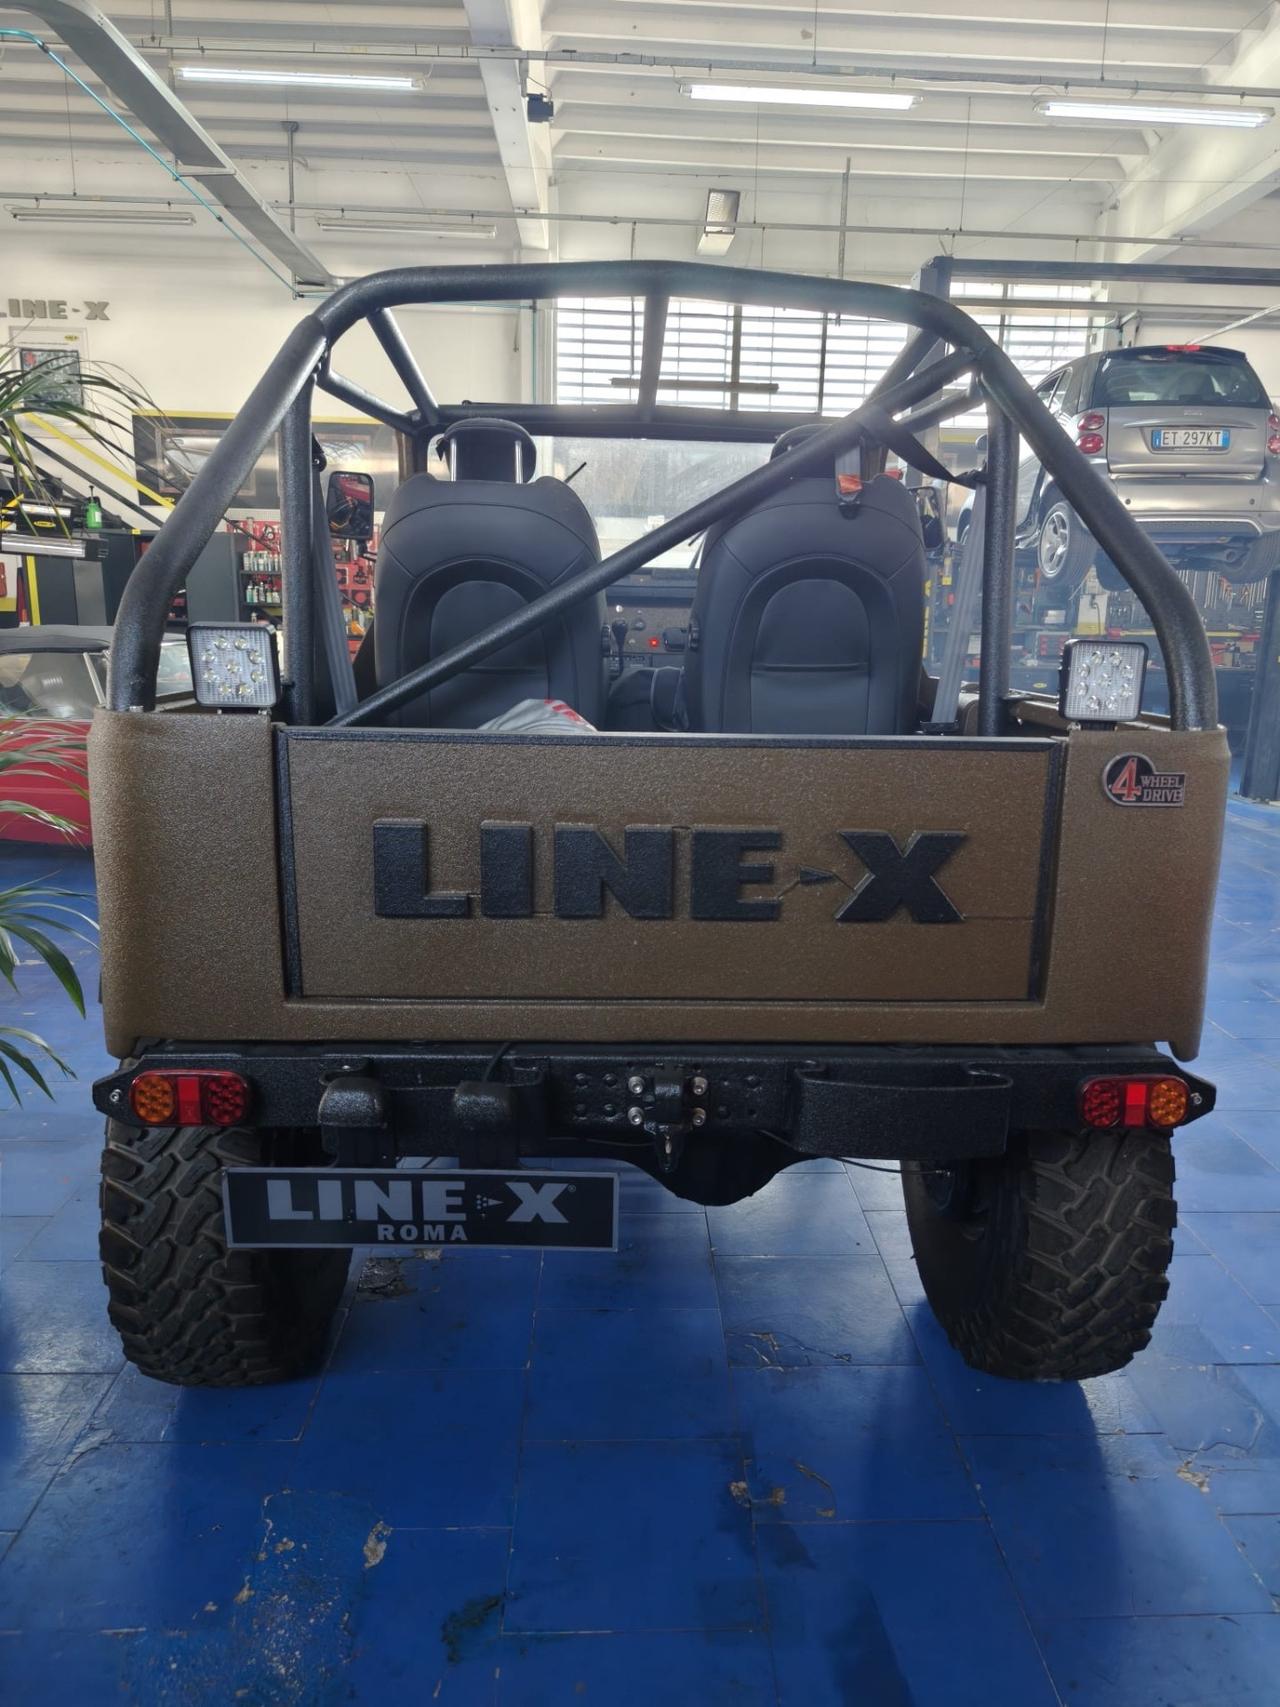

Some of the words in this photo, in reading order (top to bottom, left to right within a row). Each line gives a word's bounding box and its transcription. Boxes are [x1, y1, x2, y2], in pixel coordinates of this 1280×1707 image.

[0, 298, 110, 320] INE-X
[1162, 431, 1178, 445] ET
[1183, 431, 1221, 446] 297KT
[1111, 757, 1142, 801] 4
[1140, 775, 1183, 788] WHEEL
[1142, 789, 1184, 802] DRIVE
[377, 1223, 468, 1242] ROMA
